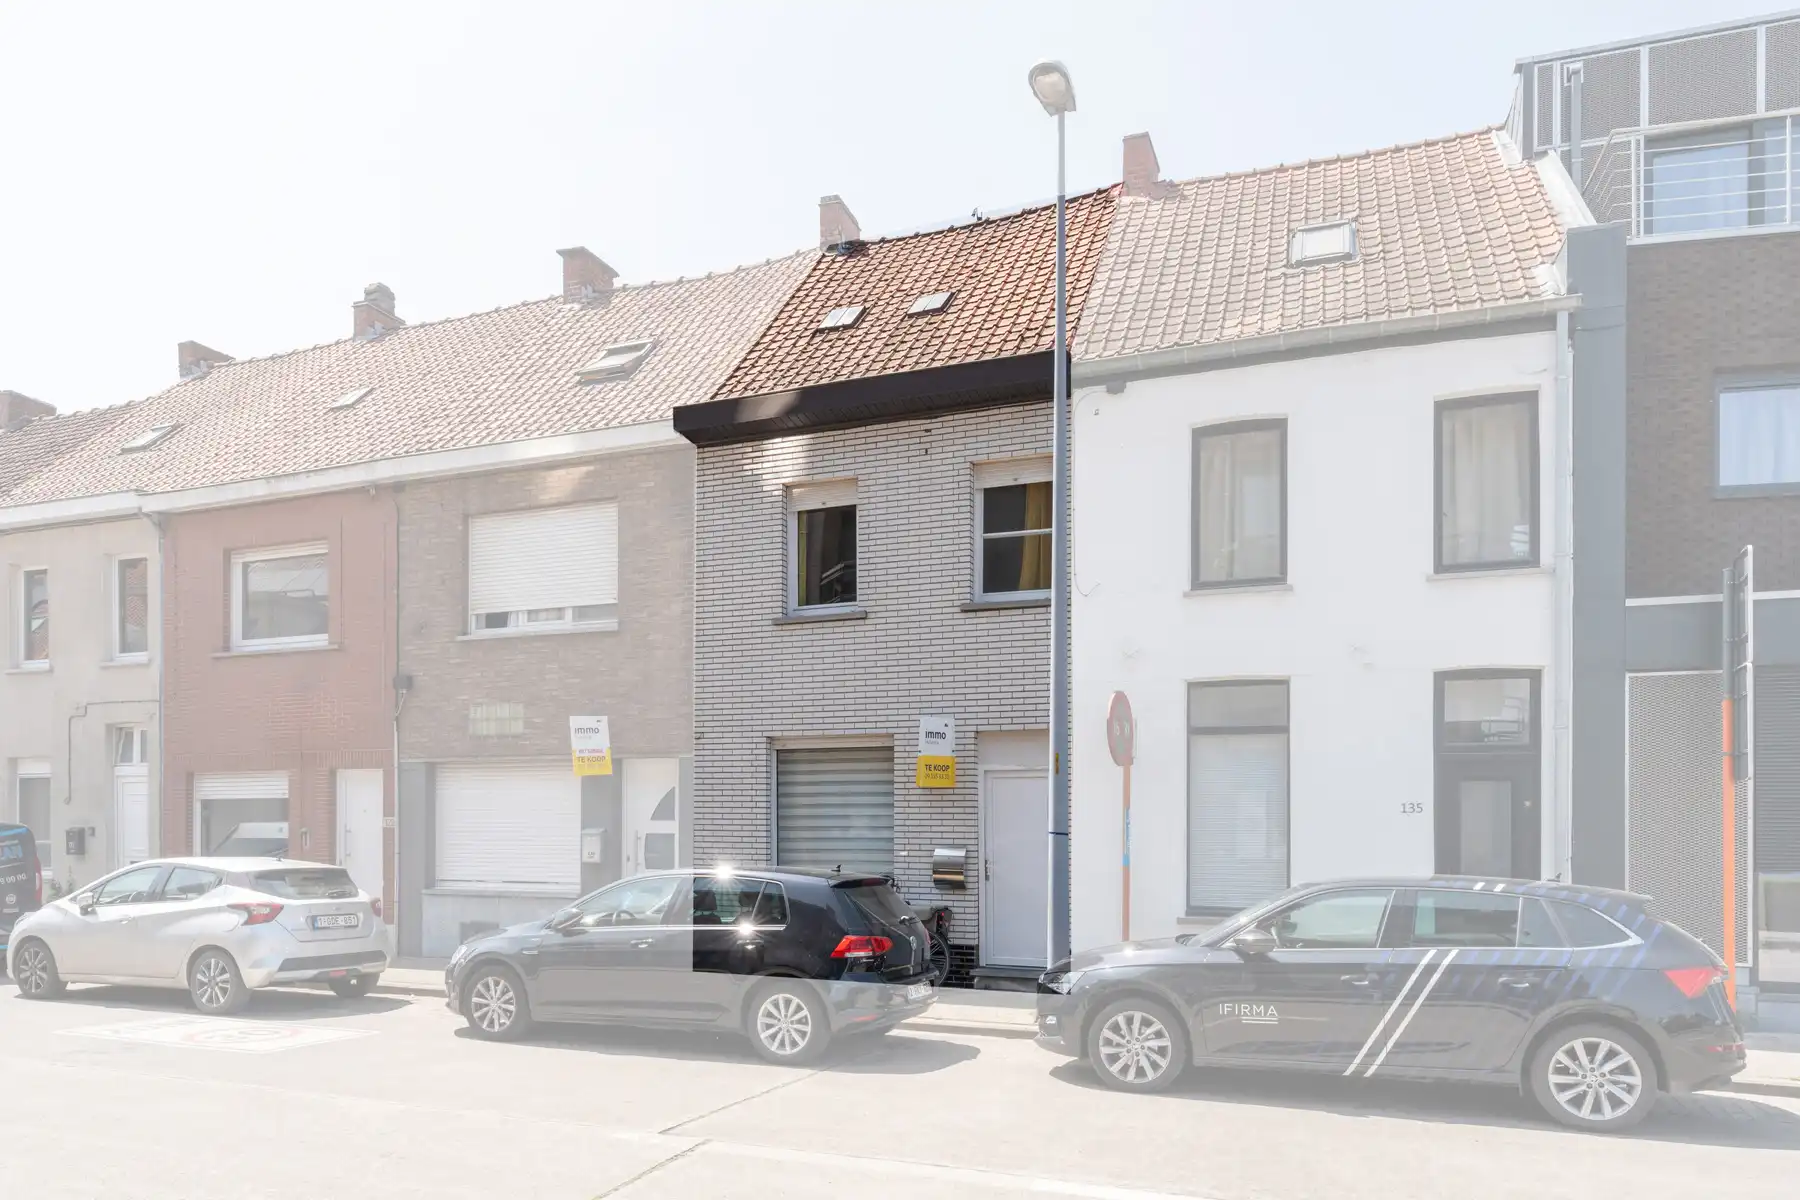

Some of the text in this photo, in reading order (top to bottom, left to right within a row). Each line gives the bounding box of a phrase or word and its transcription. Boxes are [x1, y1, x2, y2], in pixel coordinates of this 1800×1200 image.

[574, 726, 600, 735] immo
[924, 728, 947, 740] immo
[587, 754, 606, 763] KOOP
[924, 763, 950, 772] TE KOOP
[1400, 802, 1424, 814] 135
[1219, 1003, 1278, 1017] IFIRMA
